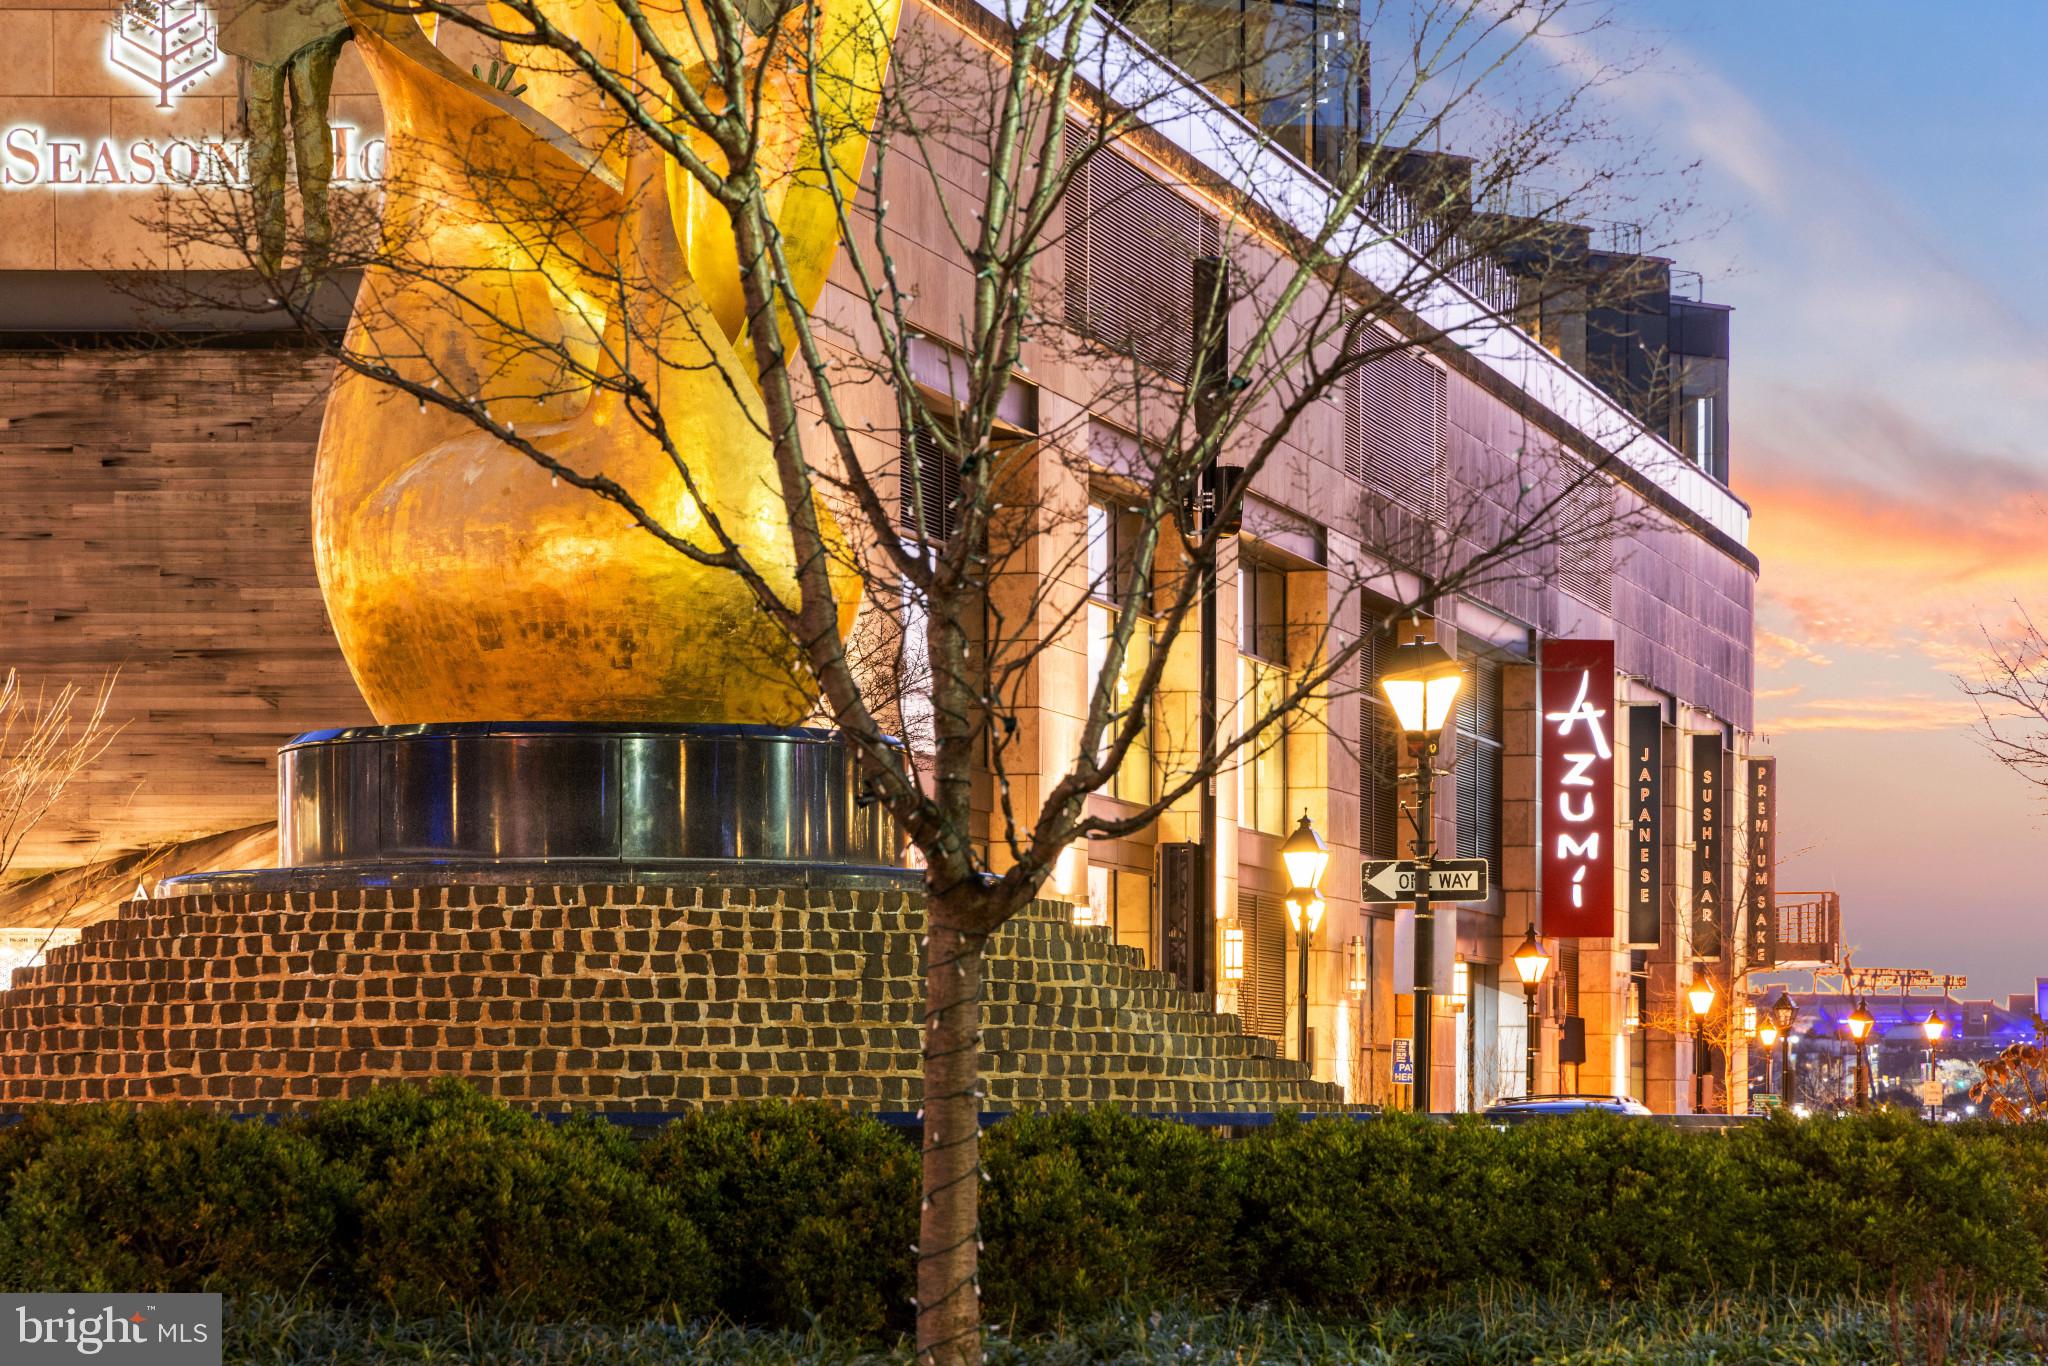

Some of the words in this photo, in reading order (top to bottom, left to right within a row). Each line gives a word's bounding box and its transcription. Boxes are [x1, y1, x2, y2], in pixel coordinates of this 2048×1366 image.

[1638, 747, 1652, 903] JAPANESE
[1702, 769, 1713, 859] SUSHI
[1755, 766, 1769, 886] PREMIUM
[1438, 872, 1473, 889] WAY
[1701, 870, 1713, 922] BAR
[1755, 895, 1768, 961] SAKE
